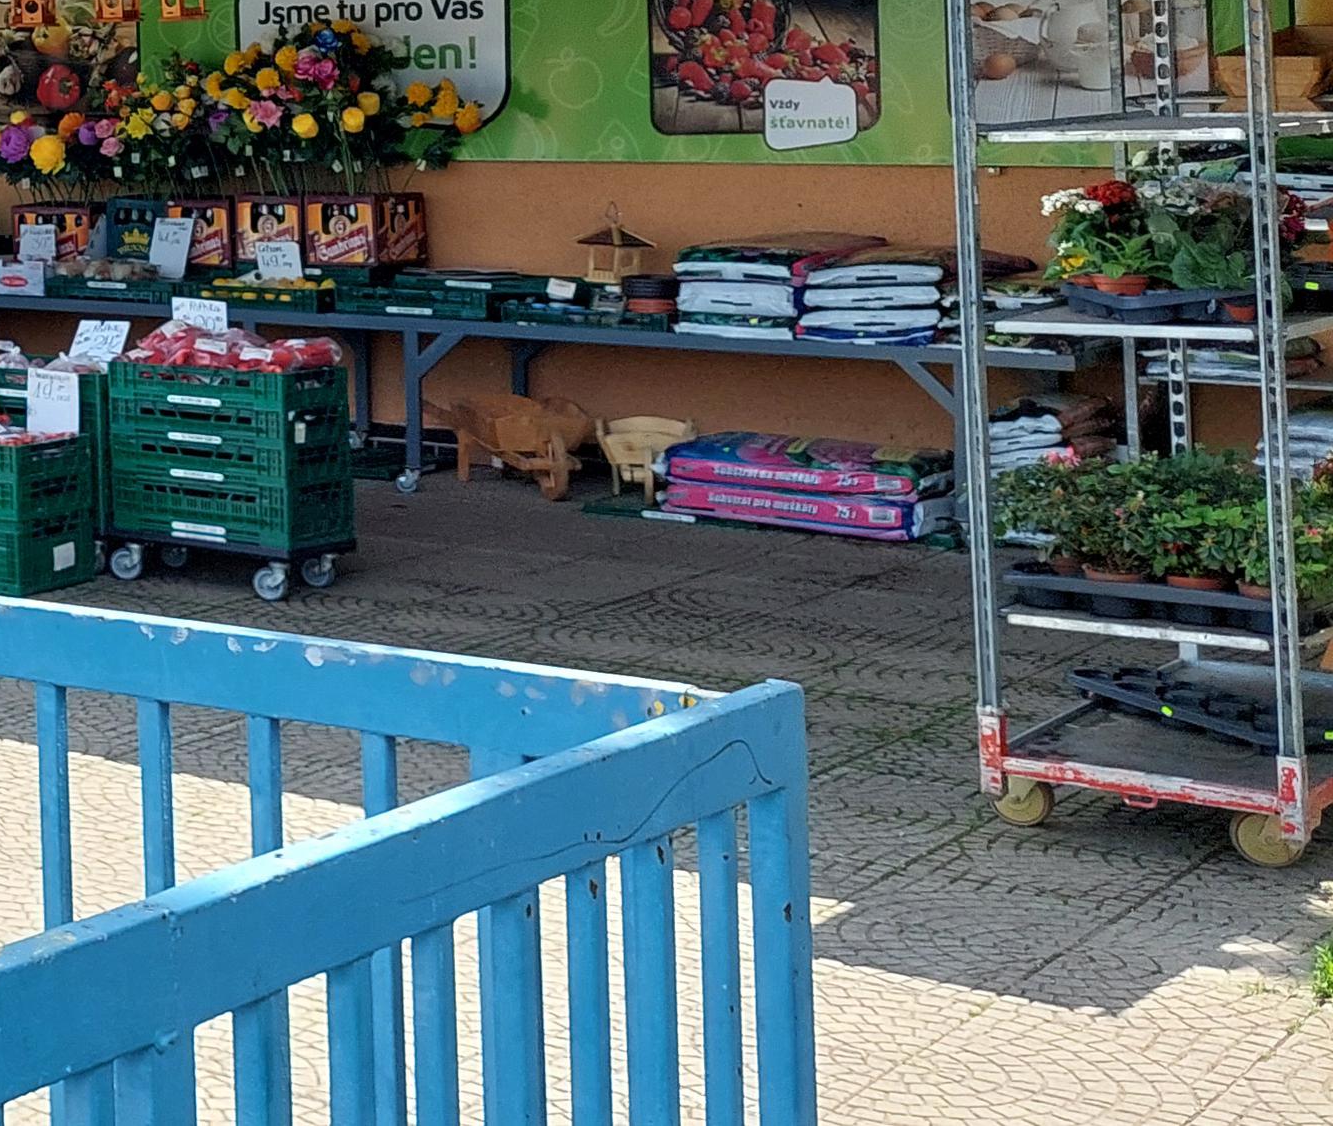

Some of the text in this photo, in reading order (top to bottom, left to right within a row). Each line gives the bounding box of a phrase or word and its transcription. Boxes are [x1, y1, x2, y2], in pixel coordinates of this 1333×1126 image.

[258, 0, 329, 25] Jsme
[336, 0, 366, 22] tu
[374, 1, 423, 28] pro
[769, 98, 801, 111] Vždy
[770, 115, 850, 129] šťavnaté!
